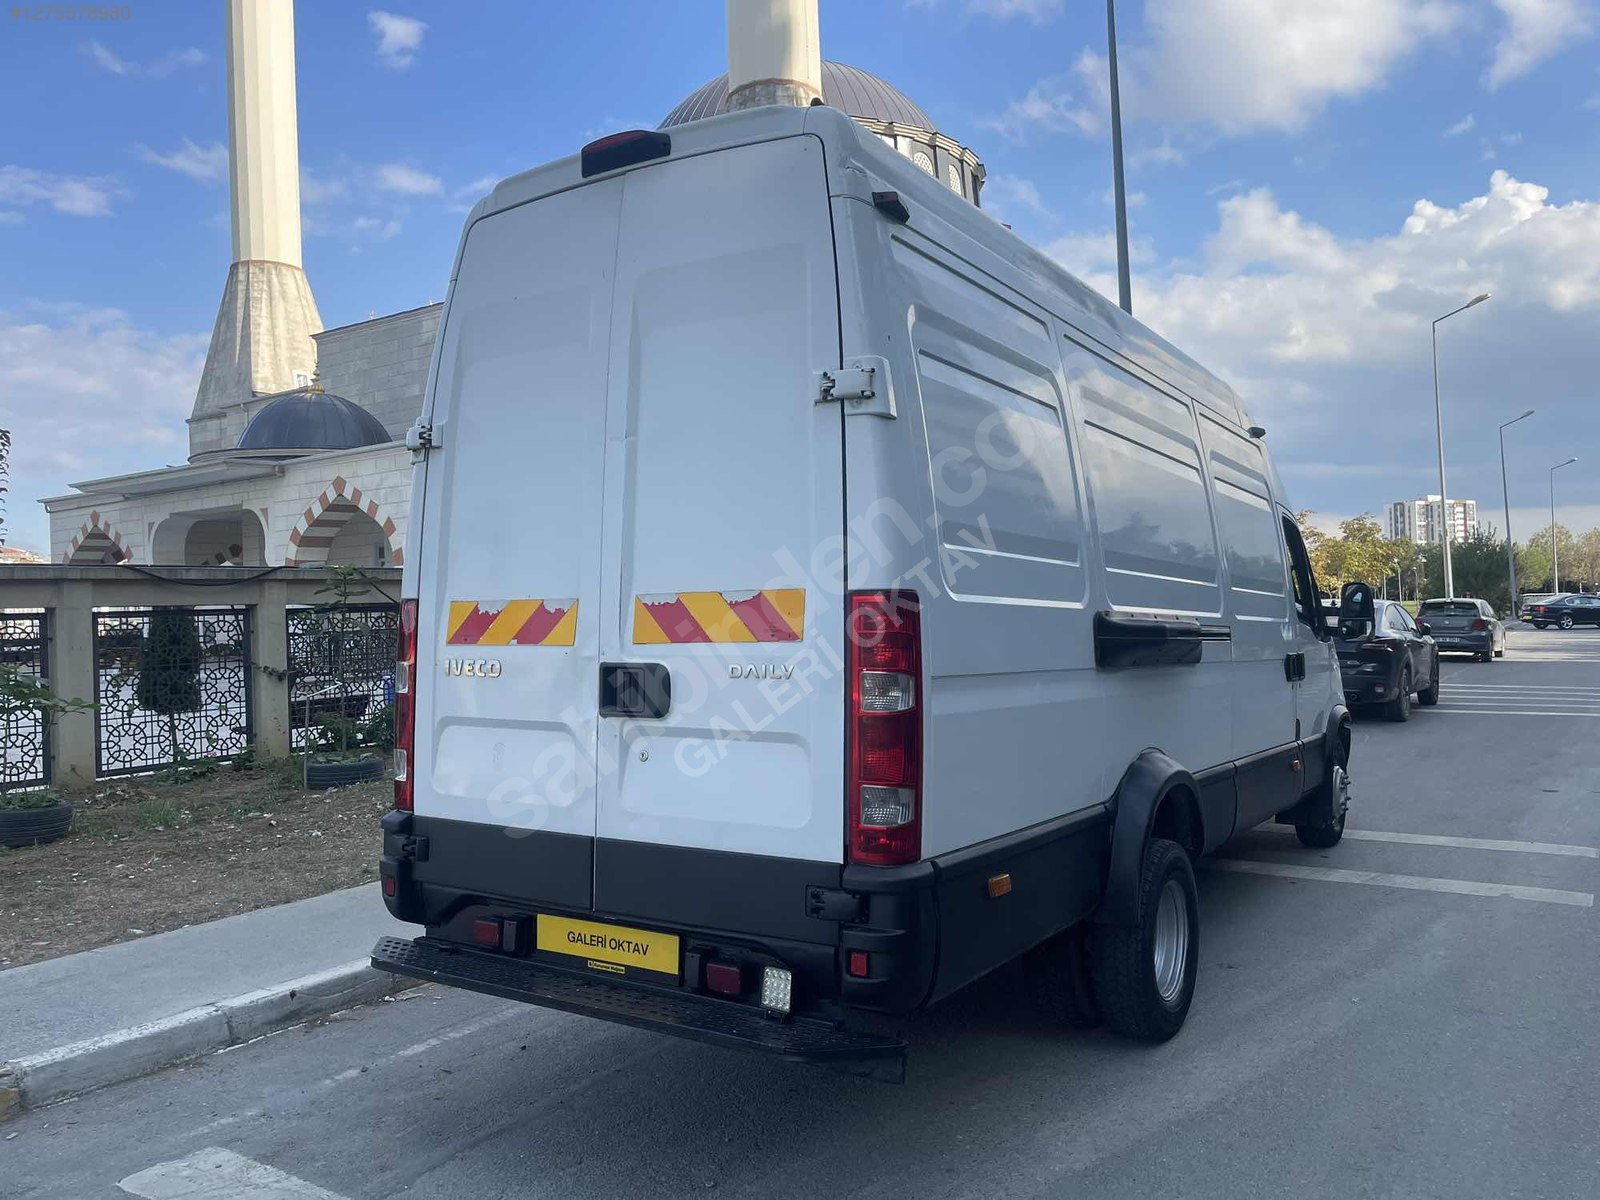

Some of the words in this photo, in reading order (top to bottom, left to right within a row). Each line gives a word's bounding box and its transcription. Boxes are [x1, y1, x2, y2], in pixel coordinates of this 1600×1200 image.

[445, 659, 502, 678] IVECO
[728, 663, 795, 680] DAILY
[567, 930, 607, 949] GALERİ
[608, 938, 649, 956] OKTAV
